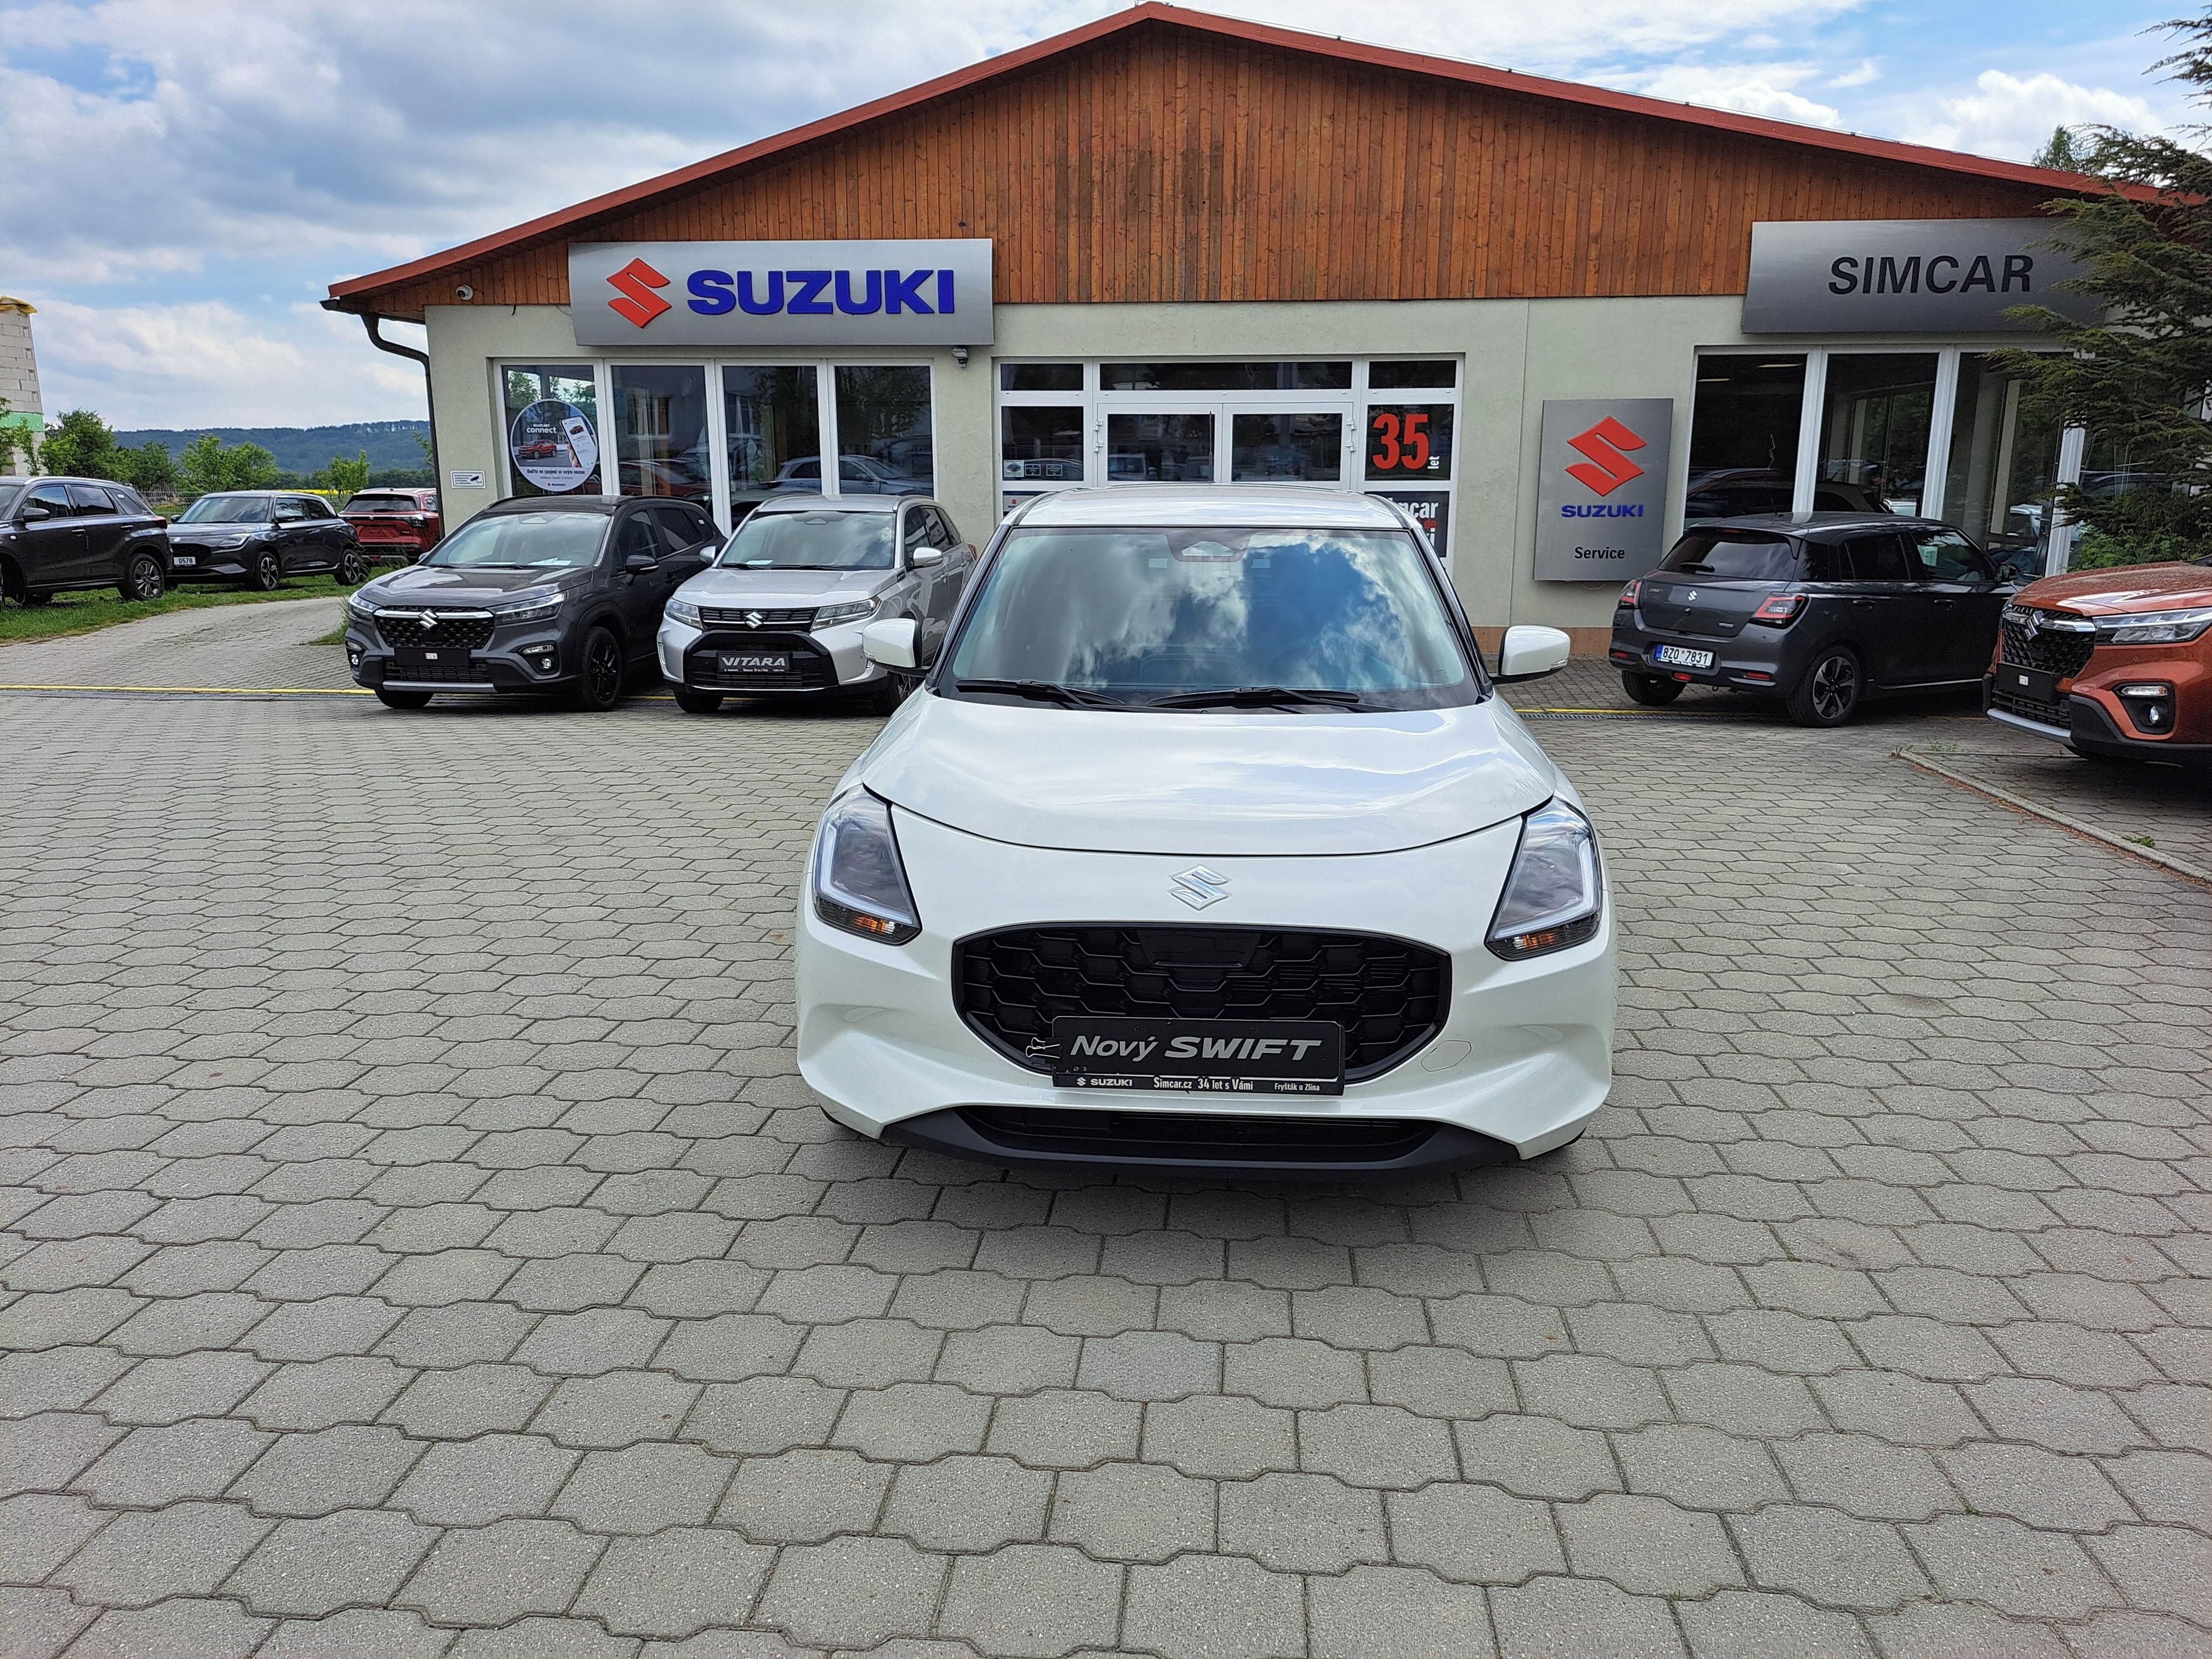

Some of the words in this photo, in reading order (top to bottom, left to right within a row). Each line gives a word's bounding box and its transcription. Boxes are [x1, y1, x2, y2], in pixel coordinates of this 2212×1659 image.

[1829, 255, 2033, 294] SIMCAR
[686, 269, 954, 315] SUZUKI
[1372, 413, 1429, 469] 35
[1427, 456, 1440, 469] let
[1561, 505, 1643, 517] SUZUKI
[1574, 547, 1625, 559] Service
[721, 657, 785, 666] VITARA
[1685, 650, 1708, 665] 7831
[1070, 1036, 1159, 1062] Nový
[1164, 1036, 1323, 1061] SWIFT
[1090, 1078, 1132, 1087] SUZUKI
[1154, 1076, 1192, 1089] Simcar.cz
[1197, 1078, 1210, 1089] 34
[1212, 1081, 1223, 1090] let
[1231, 1077, 1253, 1090] Vámi
[1274, 1082, 1297, 1091] Fryšták
[1304, 1083, 1320, 1091] Zlína
